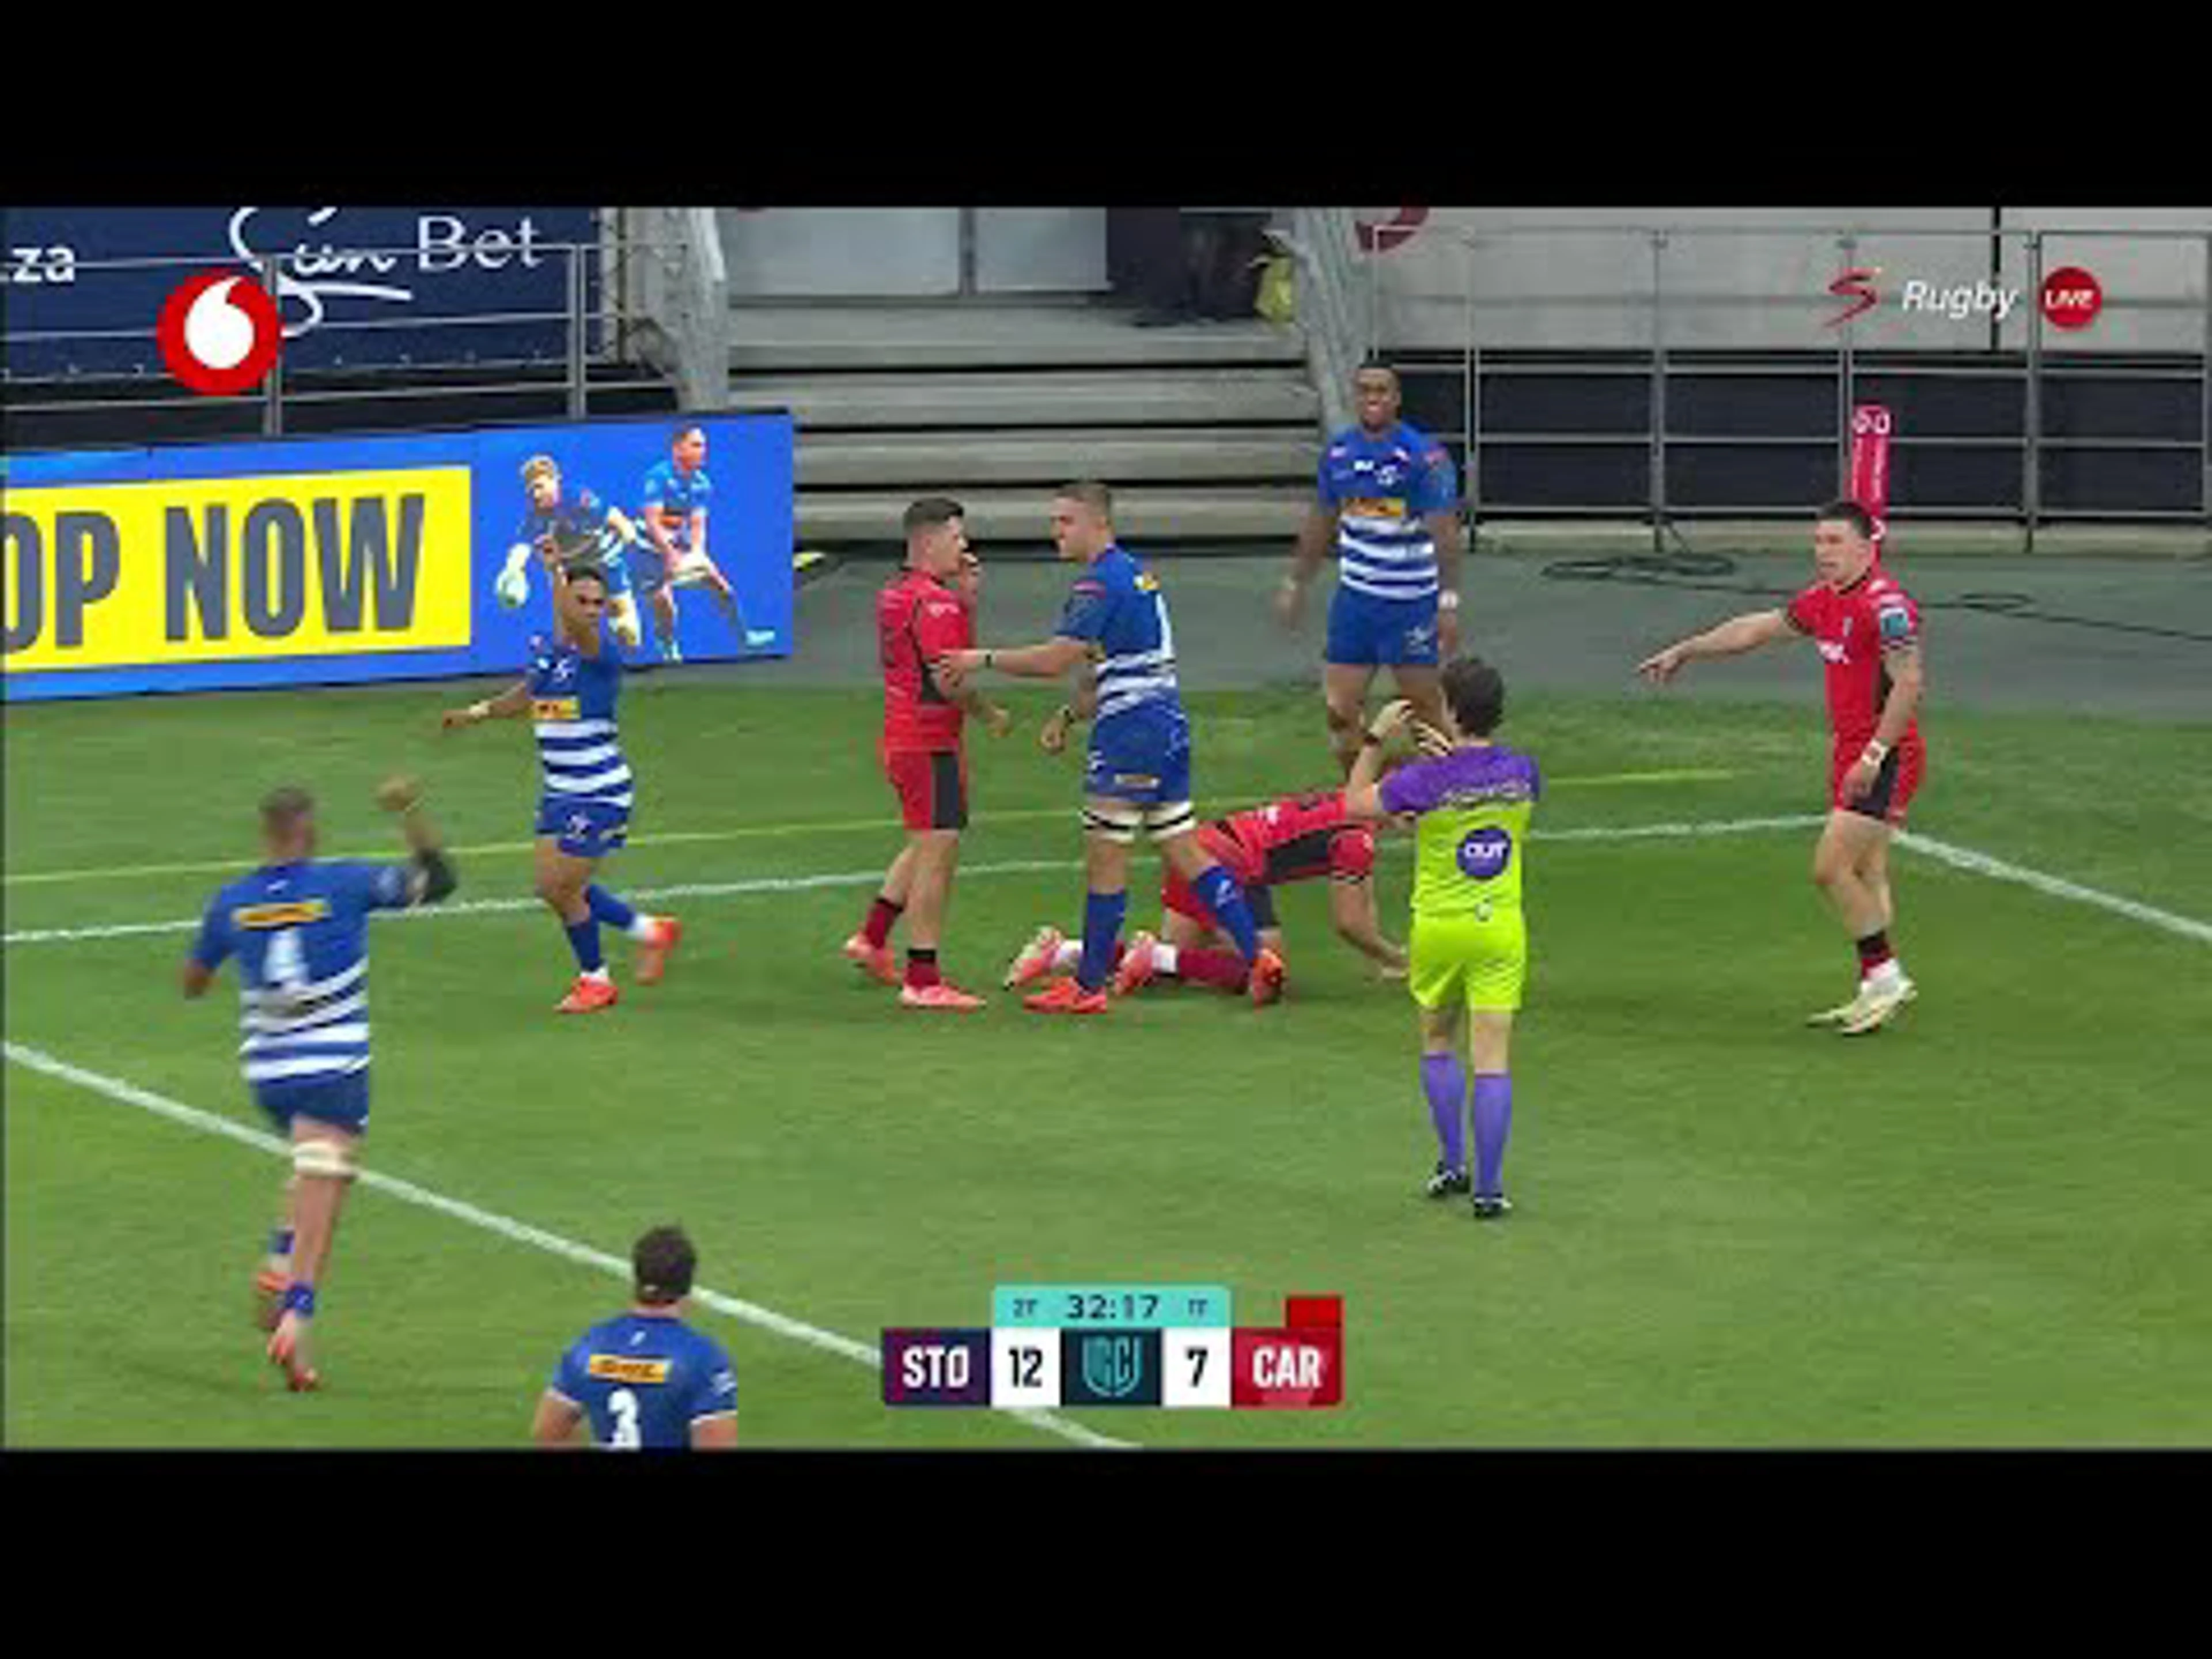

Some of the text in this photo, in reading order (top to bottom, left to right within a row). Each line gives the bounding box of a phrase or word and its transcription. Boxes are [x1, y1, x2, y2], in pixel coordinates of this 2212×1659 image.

[418, 215, 541, 270] Bet
[0, 493, 425, 654] OP NOW
